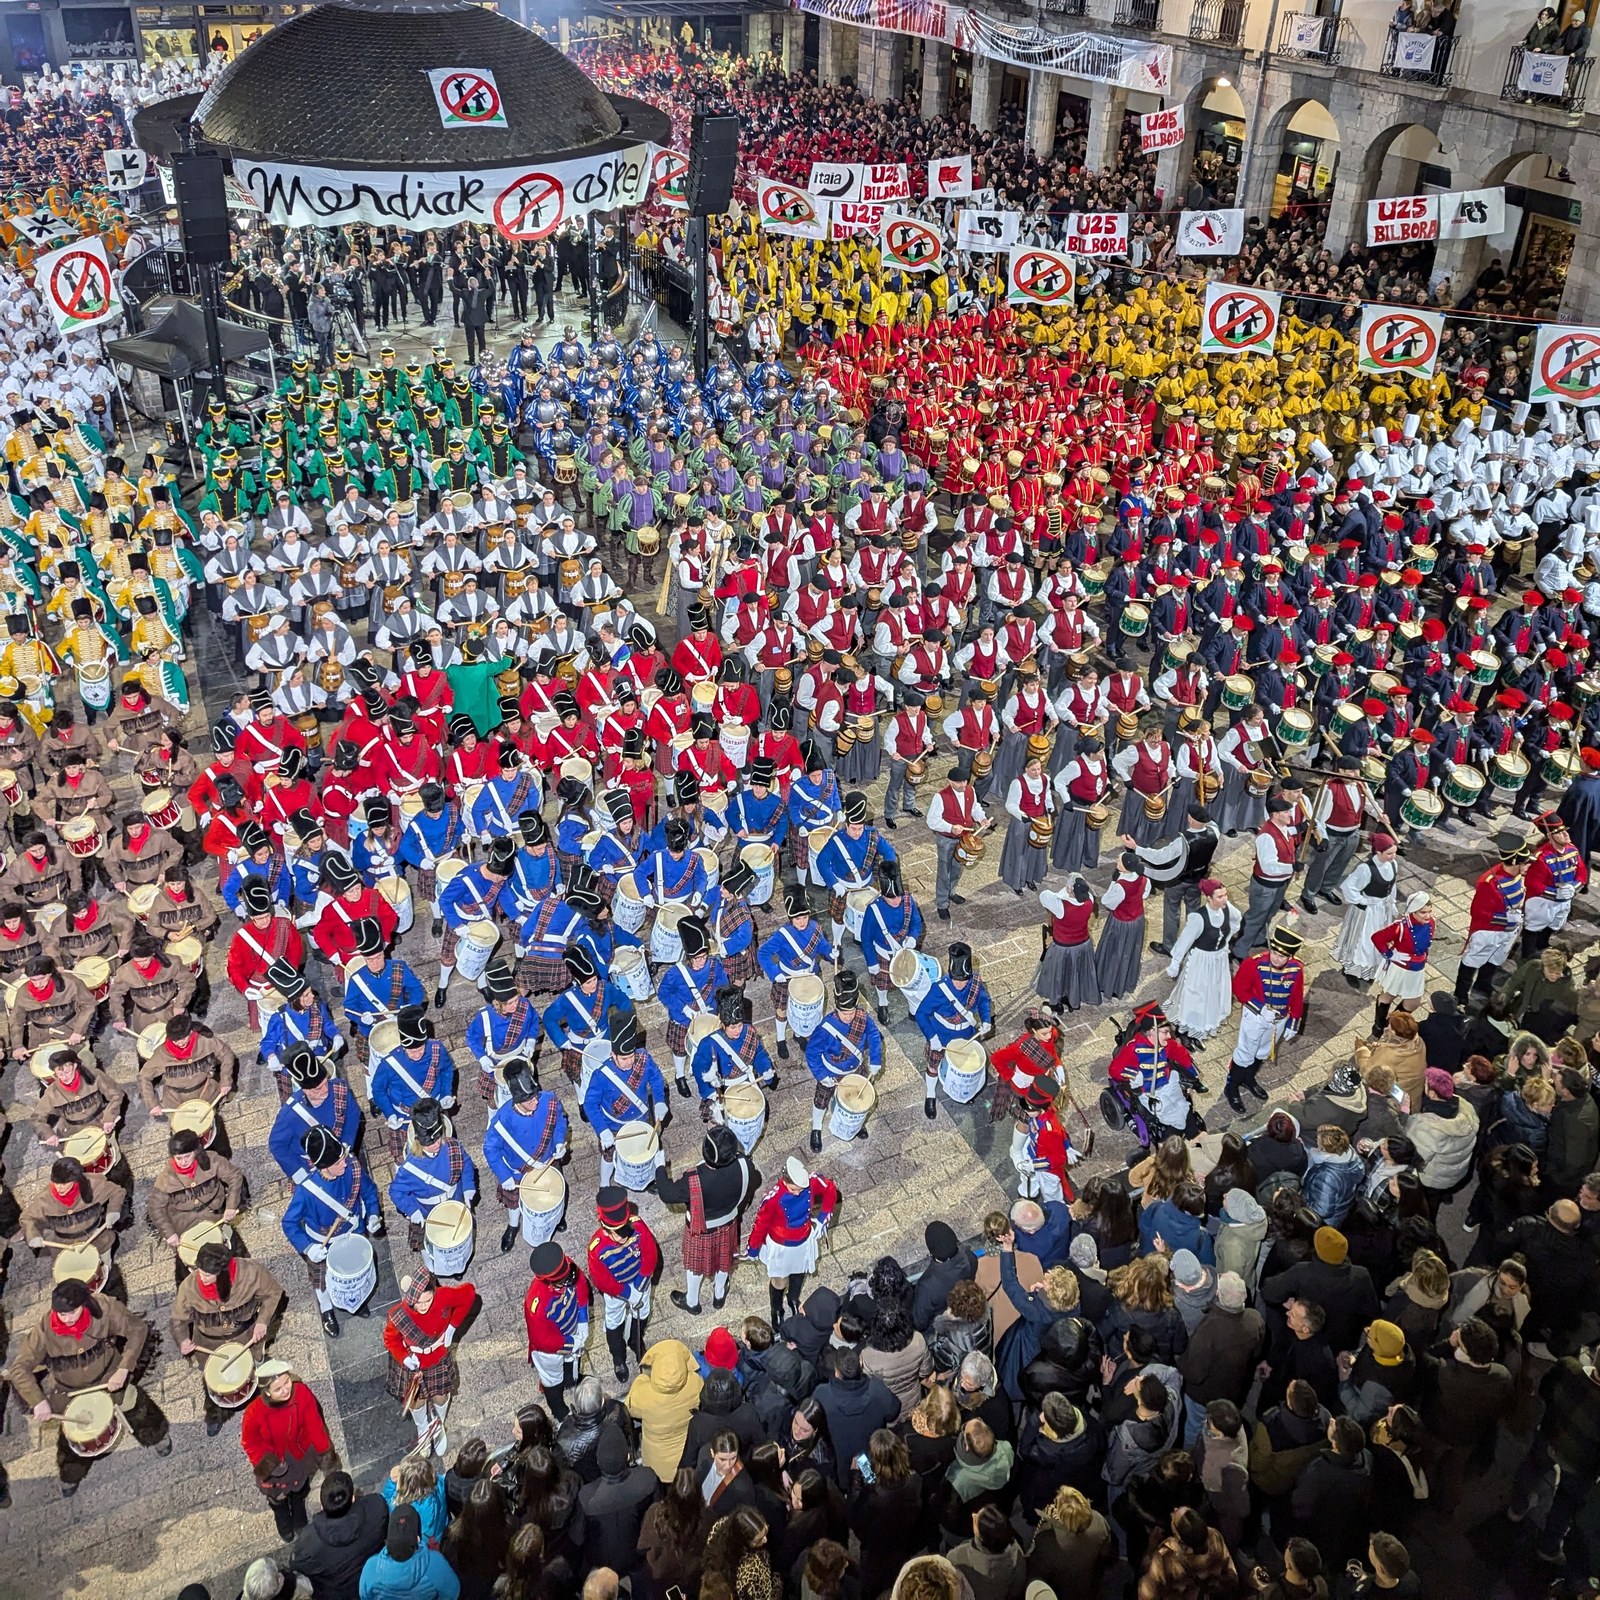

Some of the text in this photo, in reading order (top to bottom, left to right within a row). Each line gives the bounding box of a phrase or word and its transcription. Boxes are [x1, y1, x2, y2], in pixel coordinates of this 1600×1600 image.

[1146, 111, 1178, 131] U25
[1142, 128, 1184, 150] BILBORA
[573, 154, 648, 205] aske!
[813, 172, 842, 185] itaia
[871, 165, 899, 184] U25
[841, 203, 885, 224] U25
[1378, 198, 1428, 221] U25
[1076, 215, 1119, 235] U25
[1373, 220, 1438, 243] BILBORA
[1067, 236, 1127, 254] BILBORA
